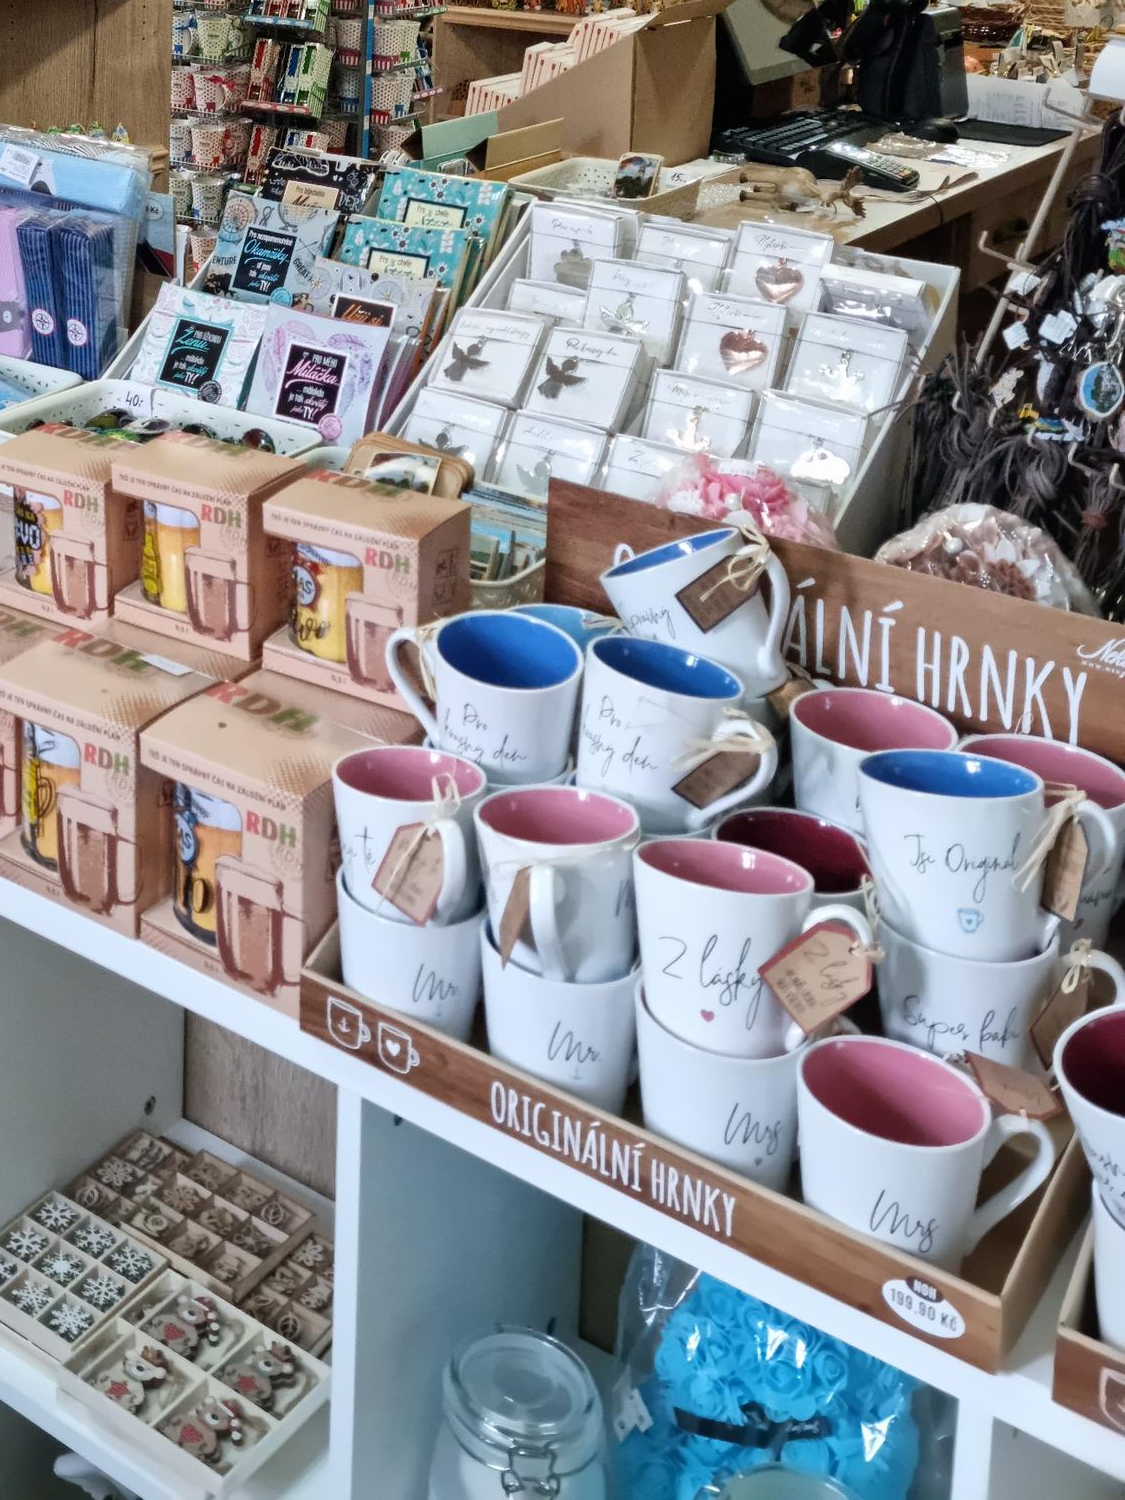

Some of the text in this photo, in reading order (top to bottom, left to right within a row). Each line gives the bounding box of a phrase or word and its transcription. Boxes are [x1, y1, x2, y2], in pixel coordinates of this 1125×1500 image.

[260, 280, 270, 292] TY!
[286, 359, 340, 386] Miláčka
[312, 354, 322, 364] PRO
[184, 372, 200, 385] TY!
[303, 406, 319, 420] TY!
[63, 489, 99, 513] RDH
[201, 504, 242, 528] RDH
[365, 547, 411, 574] RDH
[54, 628, 151, 672] RDH
[917, 627, 1088, 749] HRNKY
[206, 680, 320, 732] RDH
[83, 742, 130, 776] RDH
[245, 810, 297, 847] RDH
[658, 936, 688, 980] Z
[699, 934, 764, 1031] lásky
[902, 995, 971, 1050] Super
[724, 1102, 784, 1162] Mrs
[490, 1081, 736, 1237] ORIGINÁLNÍ HRNKY
[869, 1189, 939, 1254] Mrs
